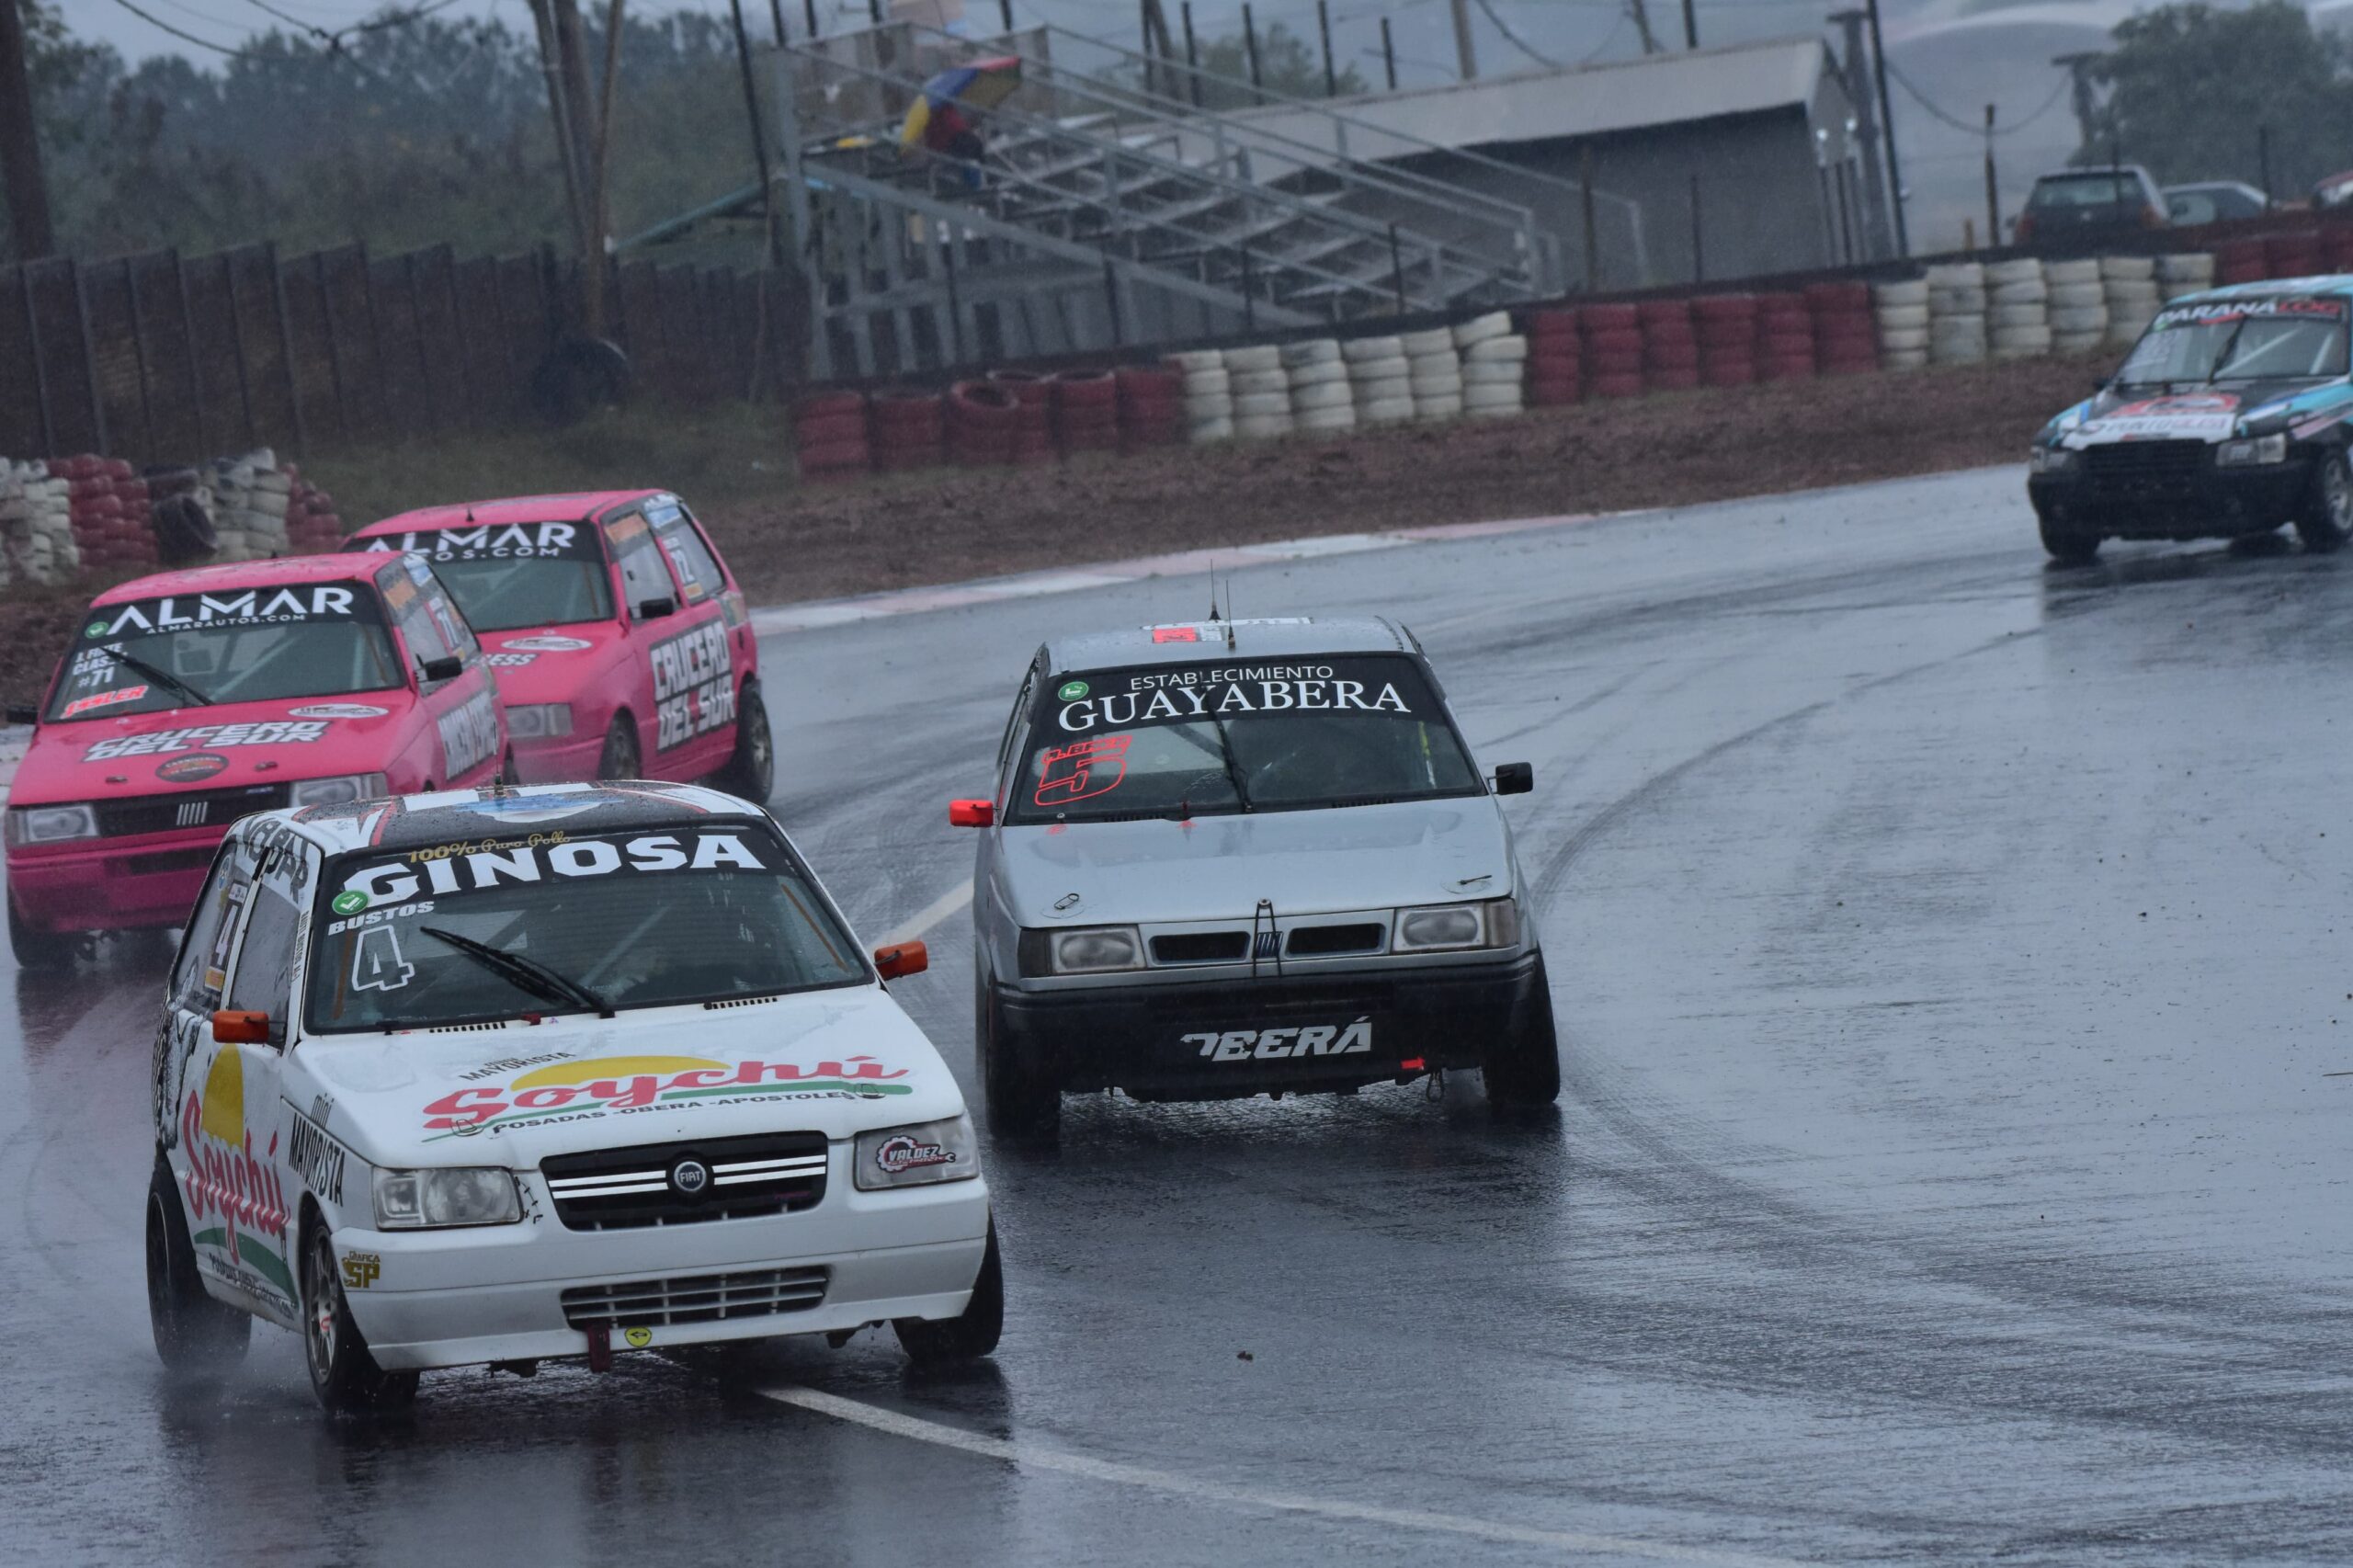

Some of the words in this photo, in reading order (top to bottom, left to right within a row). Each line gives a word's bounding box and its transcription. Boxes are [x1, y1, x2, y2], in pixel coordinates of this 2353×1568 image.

[107, 587, 355, 635] ALMAR
[147, 614, 305, 635] ALMARAUTOS.COM
[77, 665, 116, 688] #71
[650, 620, 731, 702] CRUCERO
[1130, 665, 1336, 692] ESTABLECIMIENTO
[656, 693, 696, 751] DEL
[697, 671, 735, 733] SUR
[1058, 680, 1412, 733] GUAYABERA
[83, 737, 190, 762] DEL
[203, 731, 324, 748] SUR
[87, 721, 332, 754] CRUCERO
[1033, 751, 1132, 807] 5
[409, 840, 477, 863] 100%
[481, 837, 525, 853] Puro
[528, 830, 573, 847] Pollo
[343, 834, 768, 908] GINOSA
[327, 900, 435, 937] BUSTOS
[351, 924, 415, 993] 4
[459, 1051, 577, 1081] MAYORISTA
[422, 1055, 910, 1130] Soychú
[492, 1110, 608, 1135] POSADAS
[288, 1112, 347, 1208] MAYORISTA
[888, 1145, 939, 1162] VALDEZ
[679, 1170, 701, 1184] FIAT
